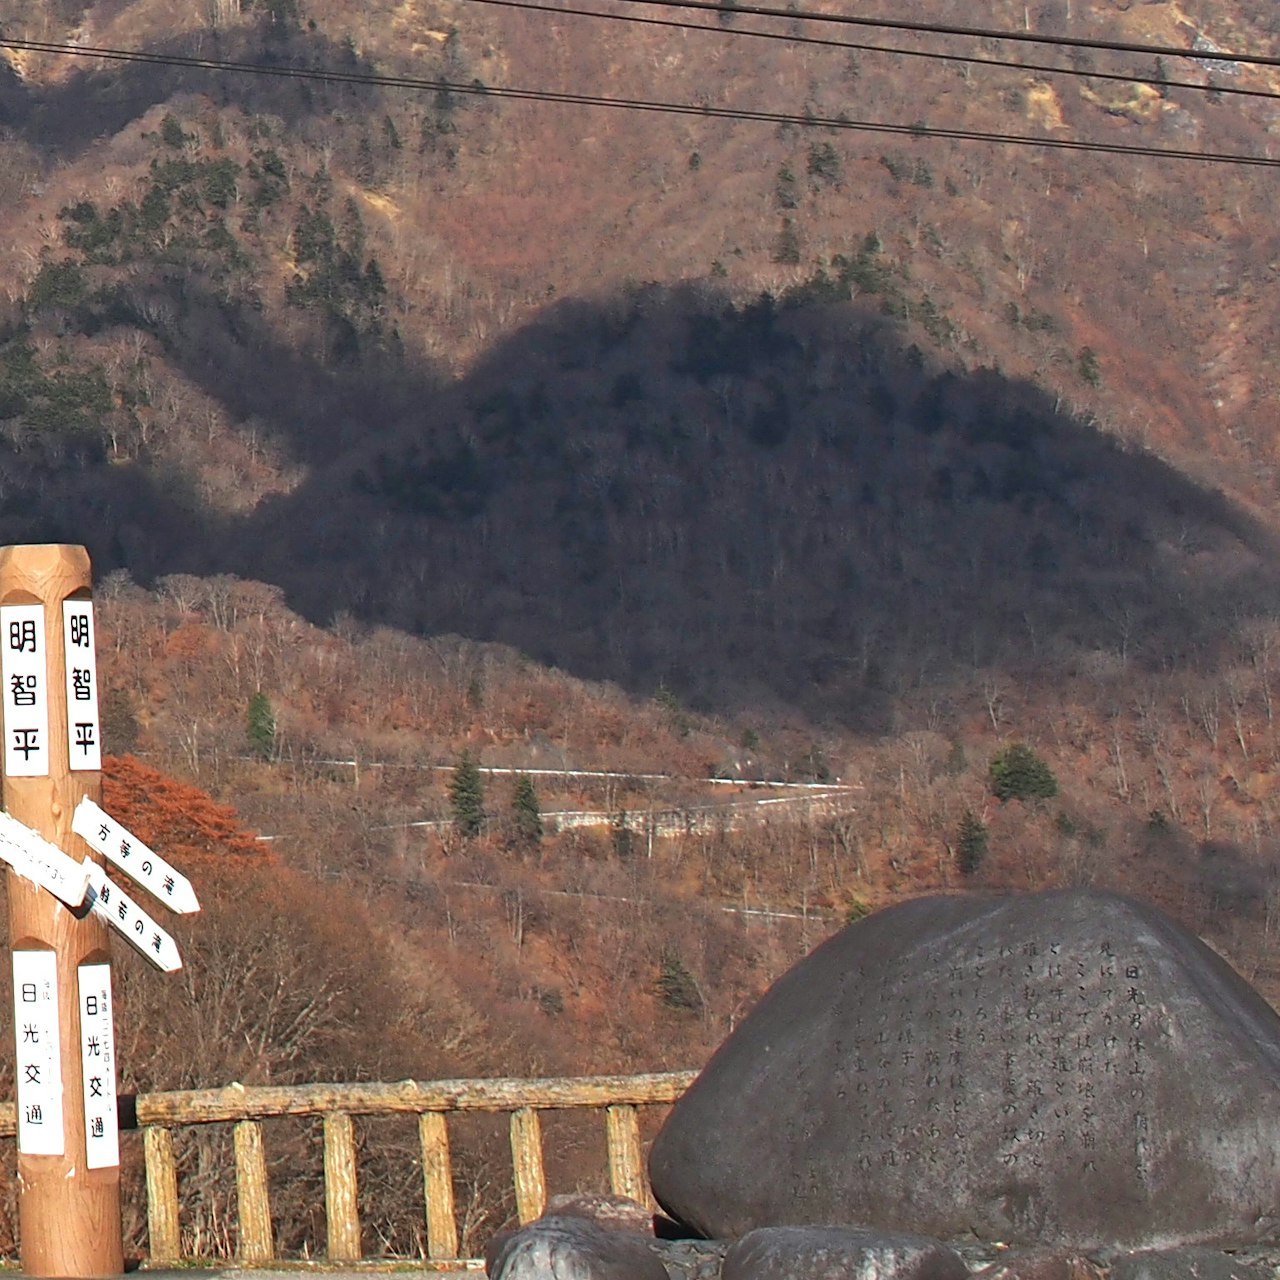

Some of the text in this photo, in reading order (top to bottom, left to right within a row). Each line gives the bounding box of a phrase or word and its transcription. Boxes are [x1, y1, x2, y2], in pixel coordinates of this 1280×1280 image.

[10, 620, 40, 761] 明智平
[71, 614, 95, 756] 明智平
[98, 823, 176, 896] 方等の滝
[99, 883, 163, 955] 般若の滝
[22, 982, 44, 1126] 日光交通
[86, 995, 104, 1138] 日光交通
